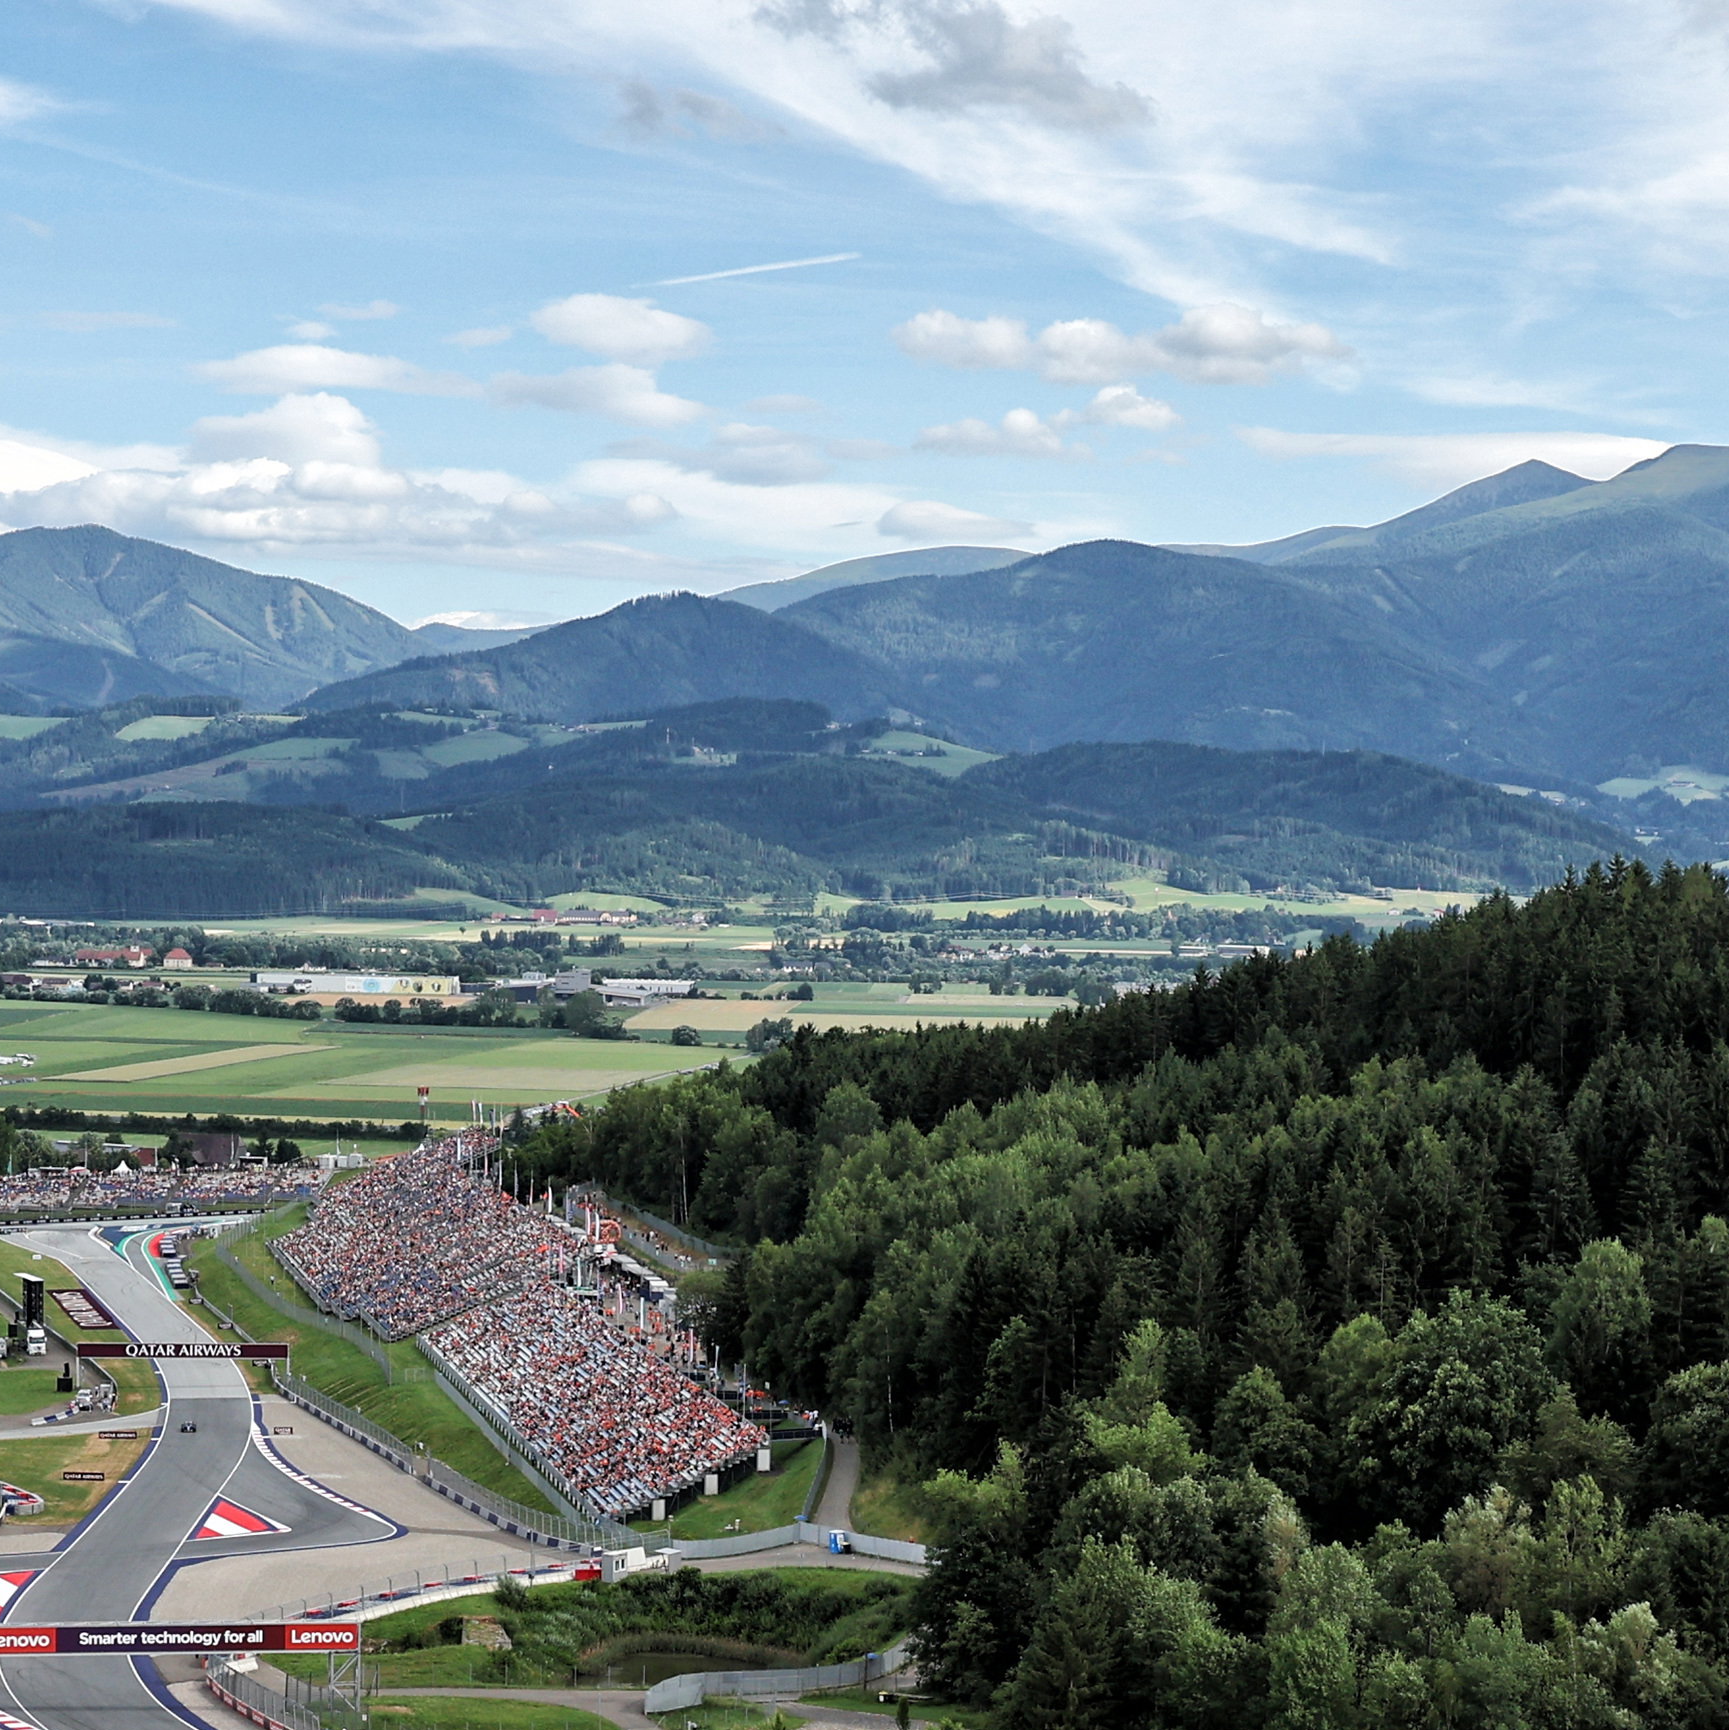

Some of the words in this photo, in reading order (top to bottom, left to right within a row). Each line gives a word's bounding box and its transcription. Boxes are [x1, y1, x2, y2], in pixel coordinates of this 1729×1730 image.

[125, 1344, 172, 1356] QATAR
[179, 1344, 241, 1356] AIRWAYS
[79, 1631, 137, 1645] Smarter
[141, 1630, 221, 1648] technology
[224, 1630, 246, 1643] for
[247, 1630, 263, 1643] all
[291, 1630, 353, 1644] Lenovo
